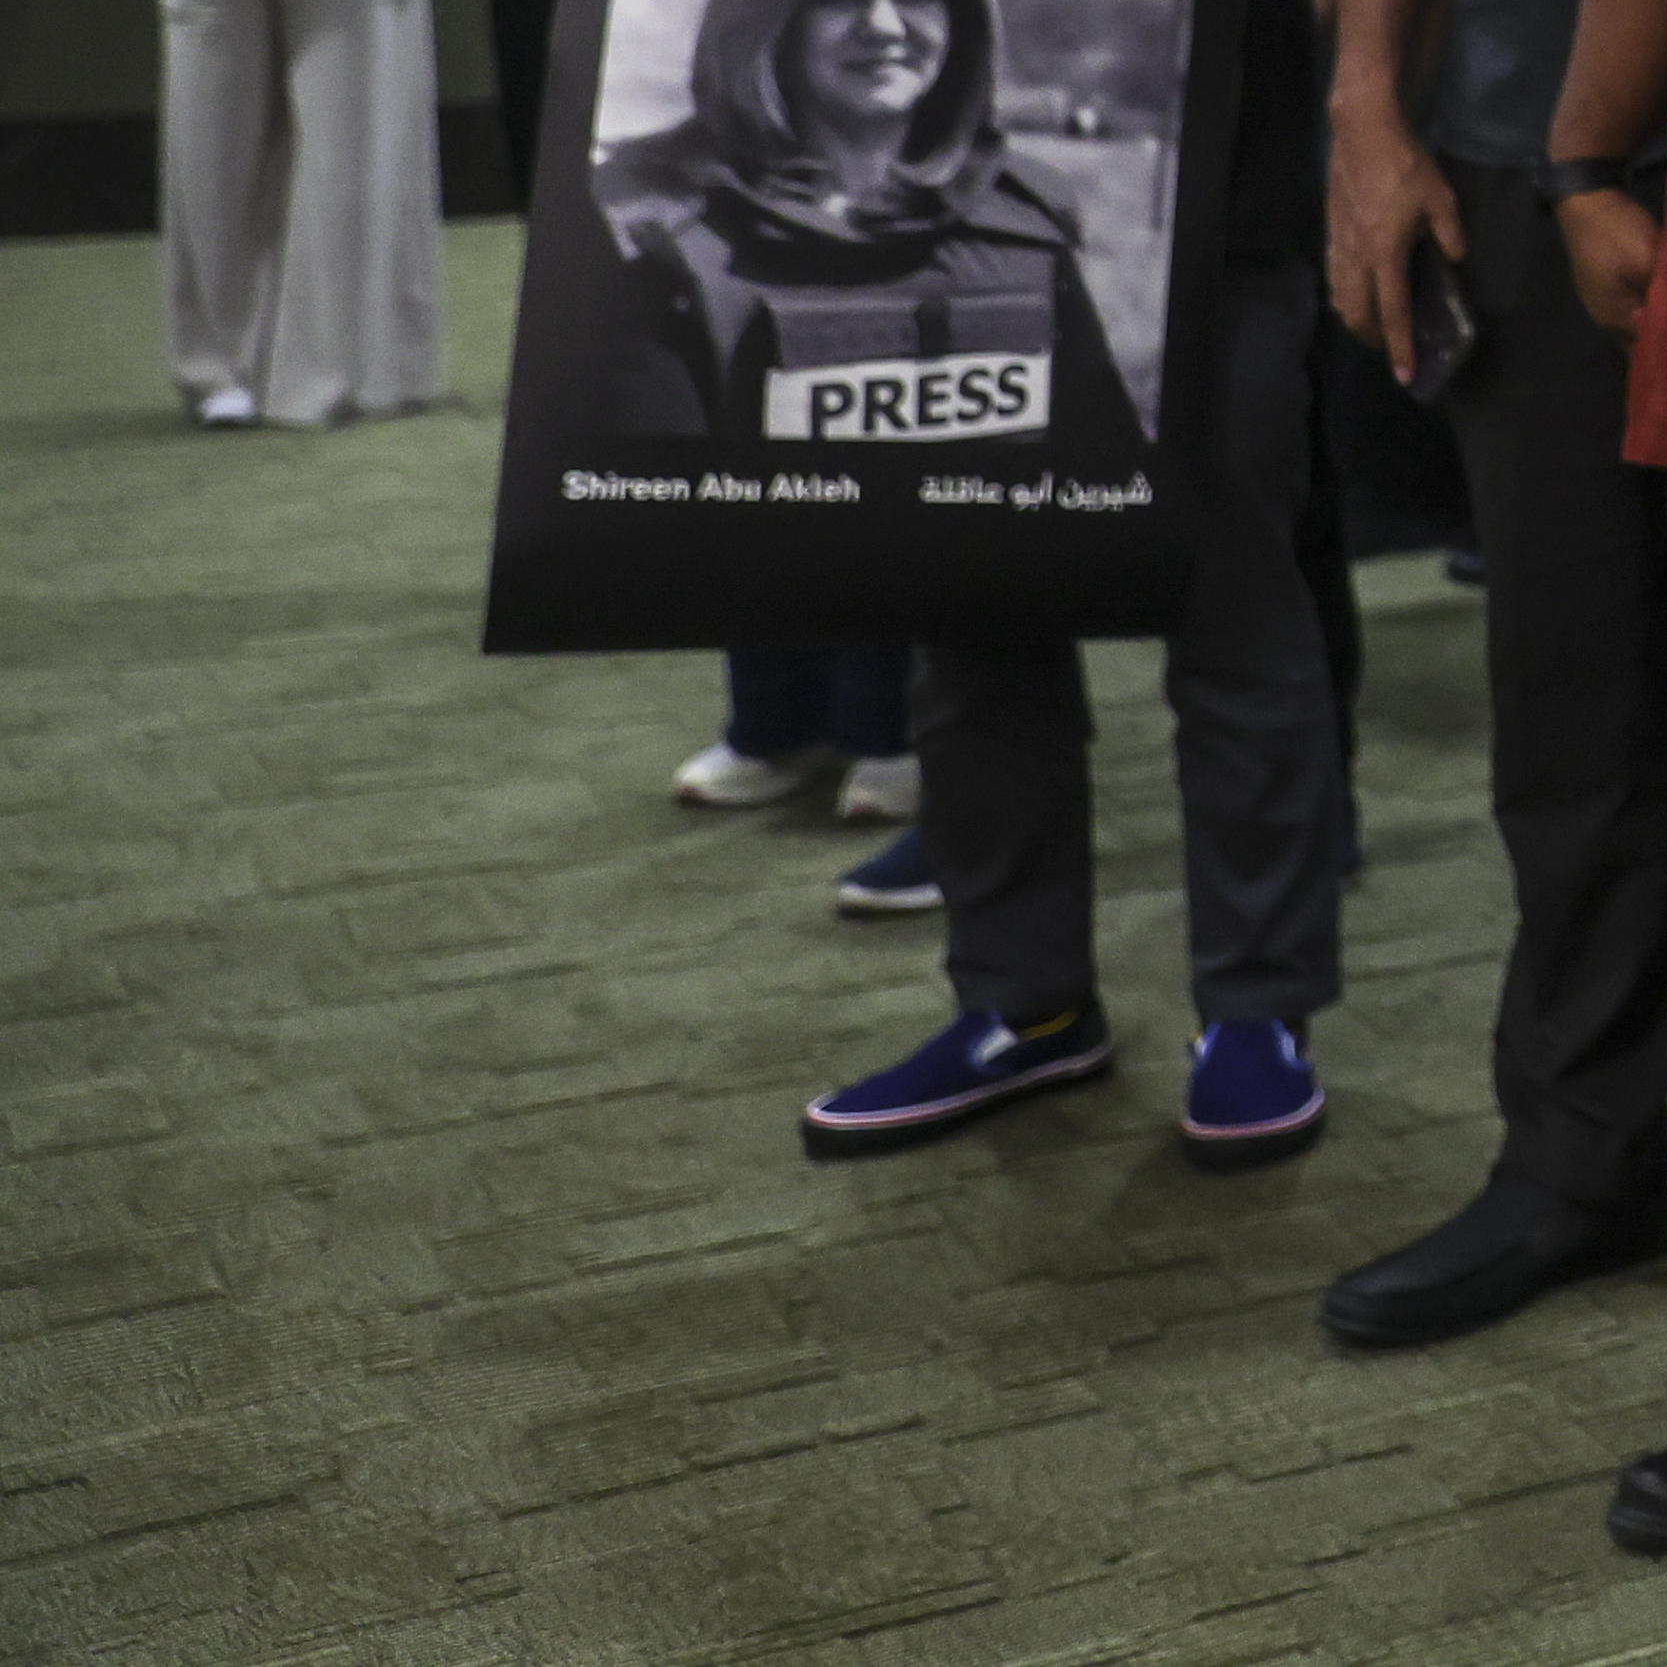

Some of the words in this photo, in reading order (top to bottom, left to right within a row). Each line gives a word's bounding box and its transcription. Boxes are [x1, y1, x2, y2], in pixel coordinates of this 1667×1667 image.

[809, 365, 1028, 436] PRESS
[562, 469, 691, 502] Shireen
[697, 472, 762, 502] Abu
[767, 473, 861, 503] Akleh
